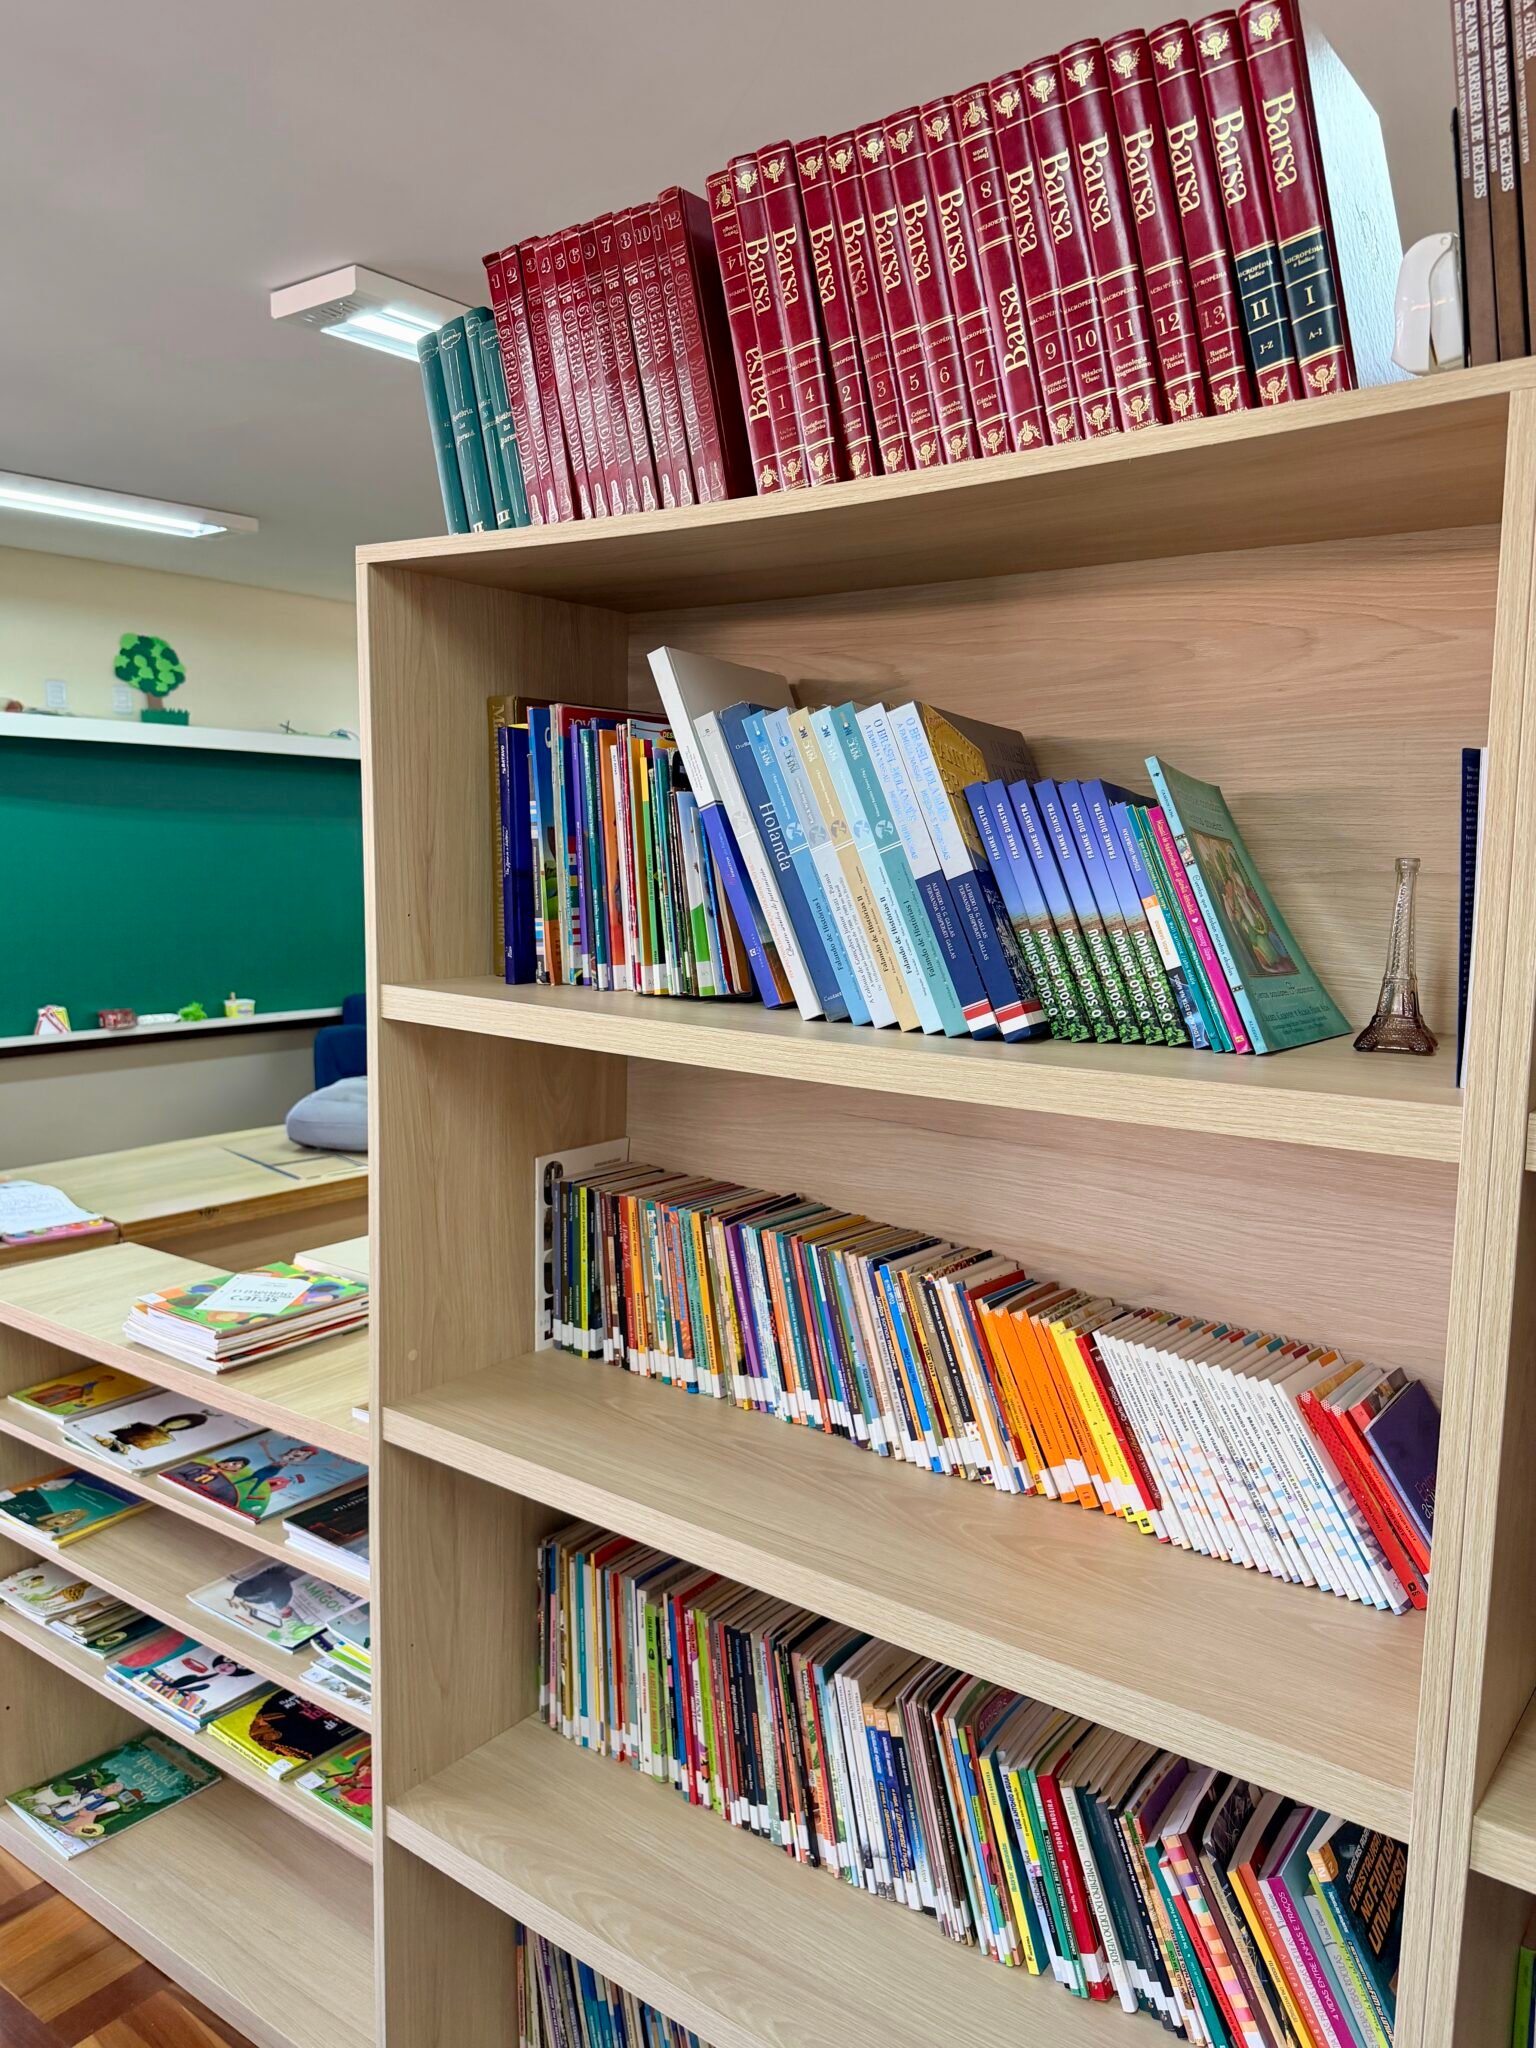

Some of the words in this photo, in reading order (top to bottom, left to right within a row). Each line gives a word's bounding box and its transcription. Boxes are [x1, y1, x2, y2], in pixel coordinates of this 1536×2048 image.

[1469, 56, 1484, 123] BARREIRA
[1495, 47, 1510, 116] BARREIRA
[1262, 88, 1298, 192] Barsa
[1471, 123, 1484, 142] DE
[1497, 117, 1510, 135] DE
[1166, 115, 1201, 218] Barsa
[1212, 106, 1247, 209] Barsa
[1473, 144, 1487, 199] RECIFES
[1500, 136, 1514, 192] RECIFES
[1079, 132, 1112, 232] Barsa
[1122, 123, 1156, 224] Barsa
[981, 181, 992, 198] 8
[1040, 148, 1073, 244] Barsa
[1006, 160, 1038, 257] Barsa
[601, 235, 612, 252] 7
[618, 232, 630, 249] 8
[633, 226, 650, 244] 10
[902, 195, 932, 285] Barsa
[938, 185, 968, 277] Barsa
[554, 252, 565, 269] 5
[567, 247, 580, 264] 6
[583, 243, 595, 259] 9
[841, 213, 869, 300] Barsa
[872, 204, 902, 293] Barsa
[506, 266, 516, 283] 2
[539, 256, 550, 273] 4
[744, 233, 771, 316] Barsa
[773, 224, 799, 309] Barsa
[810, 220, 836, 306] Barsa
[492, 275, 499, 288] 1
[1304, 285, 1316, 306] I
[1202, 305, 1226, 330] 13
[1250, 297, 1271, 322] II
[999, 283, 1030, 377] Barsa
[1113, 319, 1136, 343] 11
[1157, 312, 1181, 336] 12
[1045, 342, 1057, 360] 9
[1075, 329, 1097, 352] 10
[591, 298, 616, 374] GUERRA
[606, 380, 632, 464] MUNDIAL
[608, 292, 633, 371] GUERRA
[622, 377, 649, 463] MUNDIAL
[627, 289, 652, 368] GUERRA
[642, 375, 668, 460] MUNDIAL
[643, 283, 669, 362] GUERRA
[658, 369, 685, 457] MUNDIAL
[909, 373, 920, 391] 5
[939, 366, 950, 383] 6
[975, 359, 985, 377] 7
[514, 319, 534, 391] GUERRA
[529, 399, 549, 477] MUNDIAL
[547, 310, 570, 384] GUERRA
[561, 391, 584, 473] MUNDIAL
[562, 308, 585, 382] GUERRA
[575, 389, 600, 471] MUNDIAL
[576, 303, 600, 378] GUERRA
[591, 386, 616, 468] MUNDIAL
[745, 344, 771, 425] Barsa
[805, 387, 815, 403] 4
[842, 385, 852, 402] 2
[876, 381, 887, 398] 3
[499, 326, 519, 395] GUERRA
[513, 405, 535, 482] MUNDIAL
[778, 394, 787, 410] 1
[759, 801, 792, 872] Holanda
[987, 836, 1000, 860] FRANKE
[1006, 834, 1019, 858] FRANKE
[1030, 834, 1043, 858] FRANKE
[1056, 834, 1070, 858] FRANKE
[1081, 834, 1094, 858] FRANKE
[1103, 834, 1116, 858] FRANKE
[812, 902, 830, 932] Histórias
[860, 901, 873, 933] Histórias
[881, 903, 897, 934] Histórias
[825, 932, 833, 942] de
[871, 934, 878, 943] de
[893, 935, 901, 945] de
[1020, 928, 1041, 974] ENSINOU
[828, 942, 845, 970] Falando
[875, 944, 888, 972] Falando
[898, 945, 912, 974] Falando
[1038, 928, 1059, 975] ENSINOU
[1063, 928, 1085, 975] ENSINOU
[1089, 928, 1110, 976] ENSINOU
[1112, 929, 1134, 976] ENSINOU
[1135, 930, 1156, 978] ENSINOU
[1037, 976, 1053, 1004] SOLO
[1055, 978, 1071, 1006] SOLO
[1081, 977, 1096, 1006] SOLO
[1106, 978, 1121, 1007] SOLO
[1130, 979, 1146, 1008] SOLO
[1152, 980, 1168, 1009] SOLO
[1048, 1006, 1058, 1016] O
[1065, 1008, 1075, 1018] O
[1091, 1008, 1101, 1018] O
[1116, 1009, 1126, 1018] O
[1140, 1010, 1150, 1019] O
[1162, 1012, 1172, 1021] O
[1203, 1424, 1211, 1436] UMA
[1209, 1436, 1221, 1456] VIAGEM
[1223, 1464, 1233, 1482] TEMPO
[302, 1582, 344, 1613] AMIGOS
[1046, 1798, 1058, 1829] BANDEIRA
[1054, 1831, 1064, 1851] PEDRO
[1083, 1859, 1090, 1867] O
[1085, 1866, 1100, 1899] MENINO
[1361, 1891, 1374, 1923] NO
[1369, 1854, 1390, 1902] FIM
[1095, 1899, 1104, 1914] DO
[1278, 1891, 1296, 1923] TRAÇOS
[1368, 1848, 1407, 1955] UNIVERSO
[1099, 1913, 1111, 1937] DEDO
[1105, 1938, 1119, 1966] VERDE
[1295, 1931, 1312, 1962] LINHAS
[1309, 1961, 1325, 1989] ENTRE
[1321, 1988, 1336, 2012] VIDAS
[1332, 2013, 1339, 2021] 4
